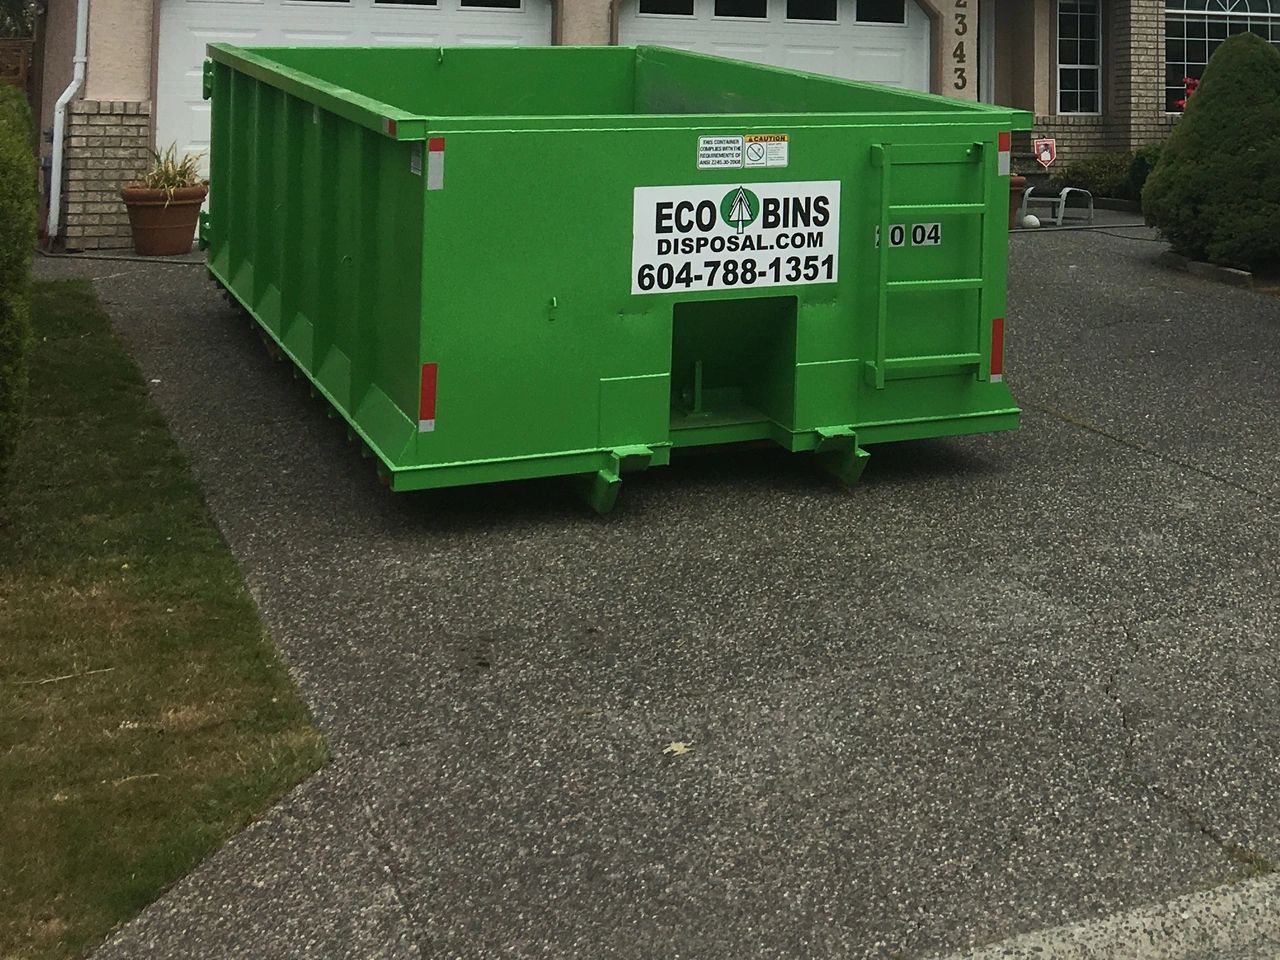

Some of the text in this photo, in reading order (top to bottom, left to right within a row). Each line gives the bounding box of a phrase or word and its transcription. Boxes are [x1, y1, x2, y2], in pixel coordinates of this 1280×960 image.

[655, 195, 830, 234] ECO BINS
[657, 231, 824, 256] DISPOSAL.COM
[637, 254, 834, 291] 604-788-1351
